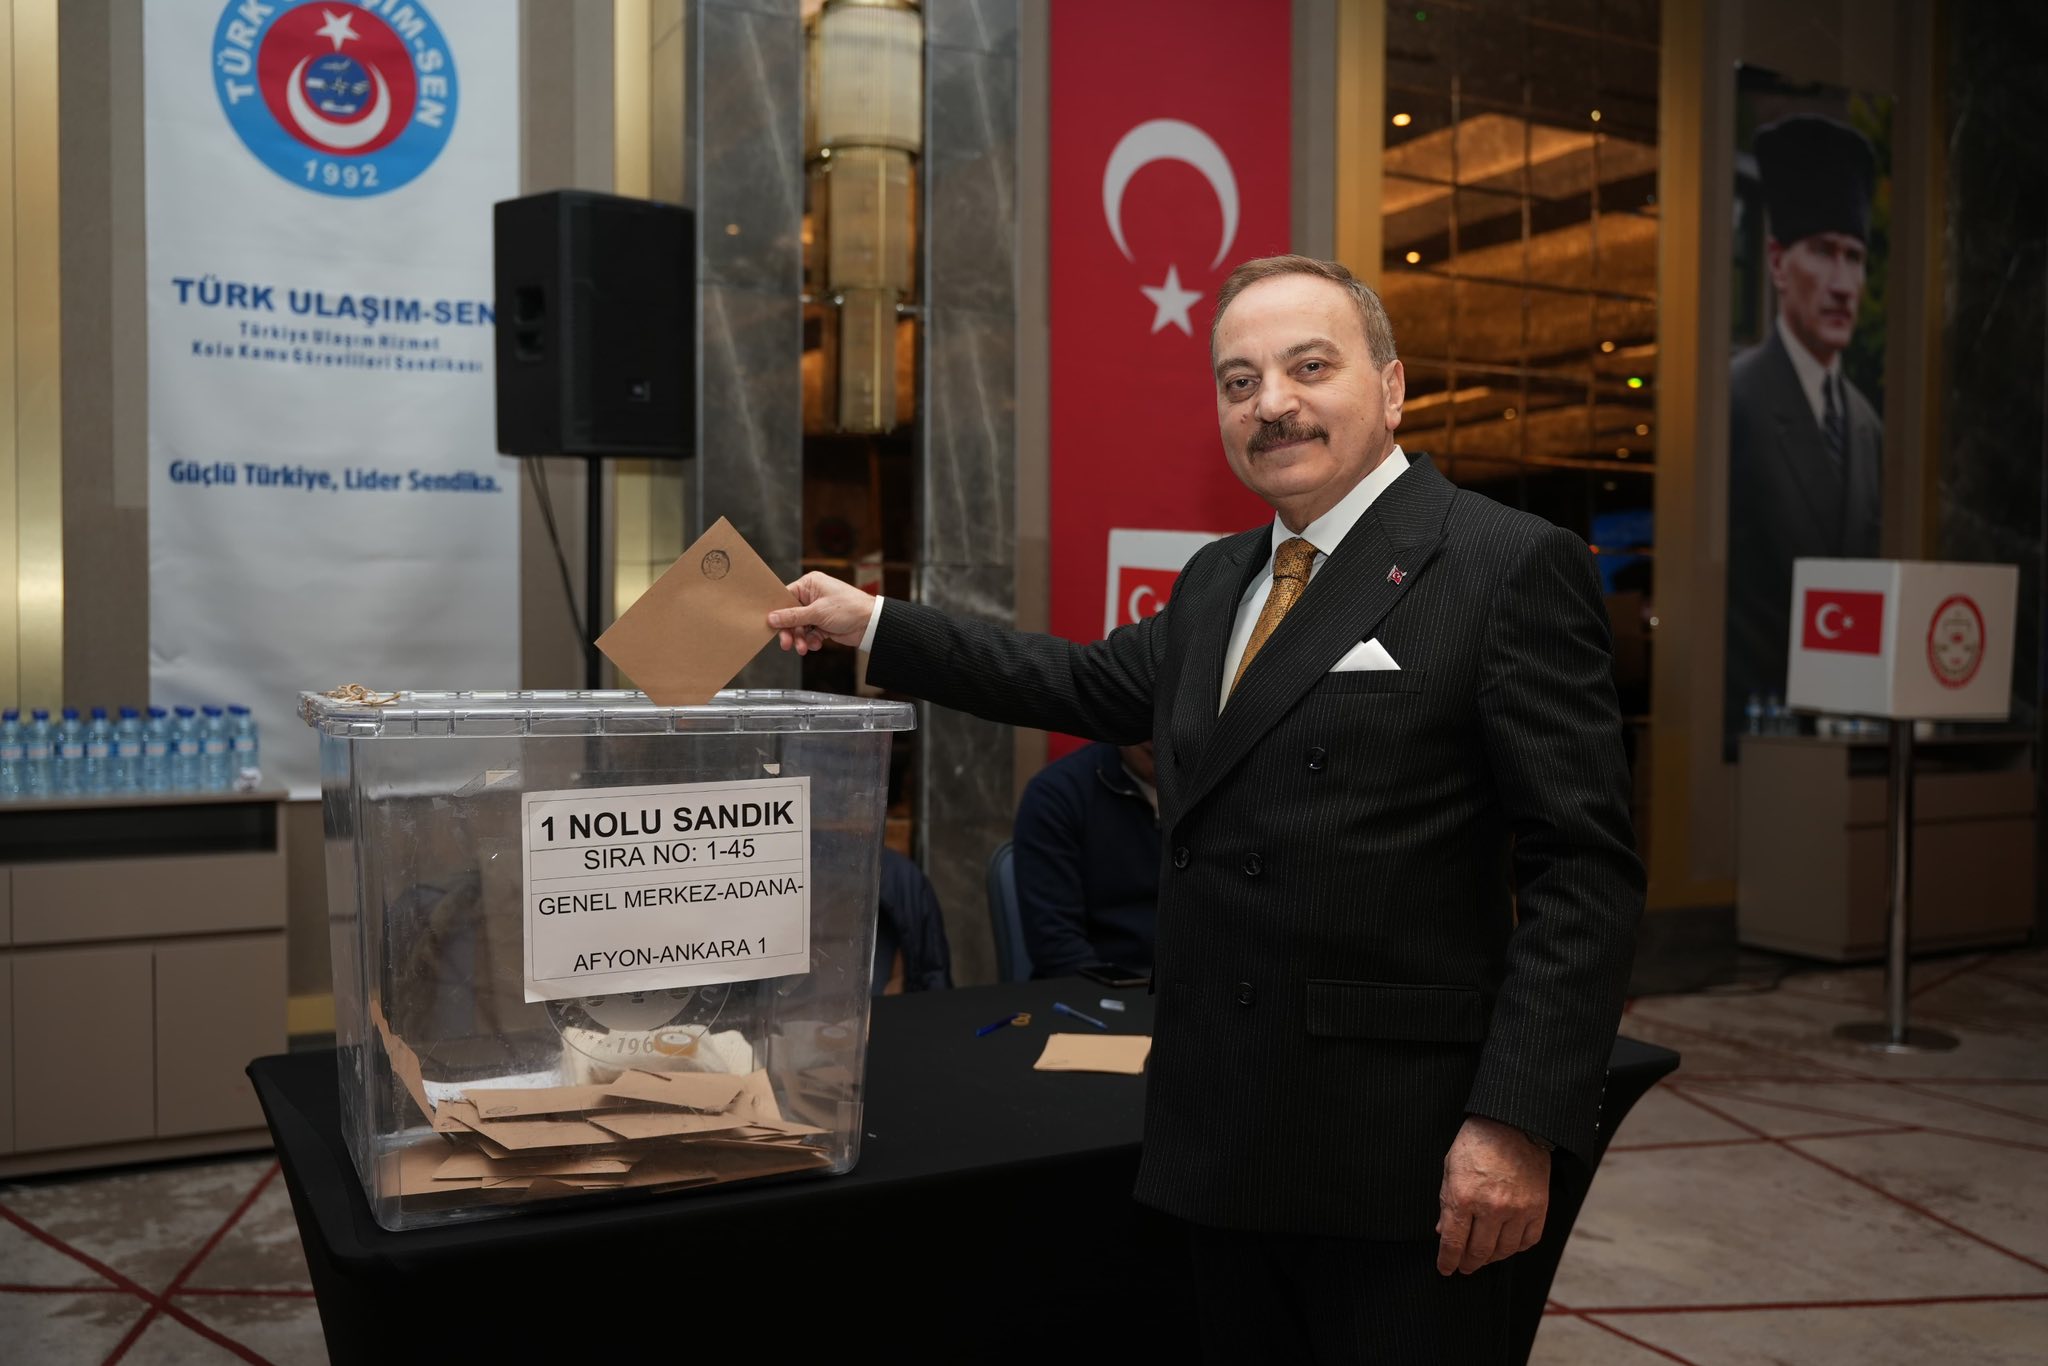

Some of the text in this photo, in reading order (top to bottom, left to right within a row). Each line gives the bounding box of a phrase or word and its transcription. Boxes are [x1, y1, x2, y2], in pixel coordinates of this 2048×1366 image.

[217, 0, 275, 105] TÜRK
[305, 159, 379, 188] 1992
[172, 274, 496, 327] TÜRK ULAŞIM-SEN
[168, 458, 502, 493] Güçlü Türkiye, Lider Sendika.
[541, 800, 795, 842] 1 NOLU SANDIK
[583, 837, 756, 870] SIRA NO: 1-45
[538, 877, 804, 916] GENEL MERKEZ-ADANA-
[573, 936, 767, 972] AFYON-ANKARA 1
[616, 1036, 660, 1055] 196
